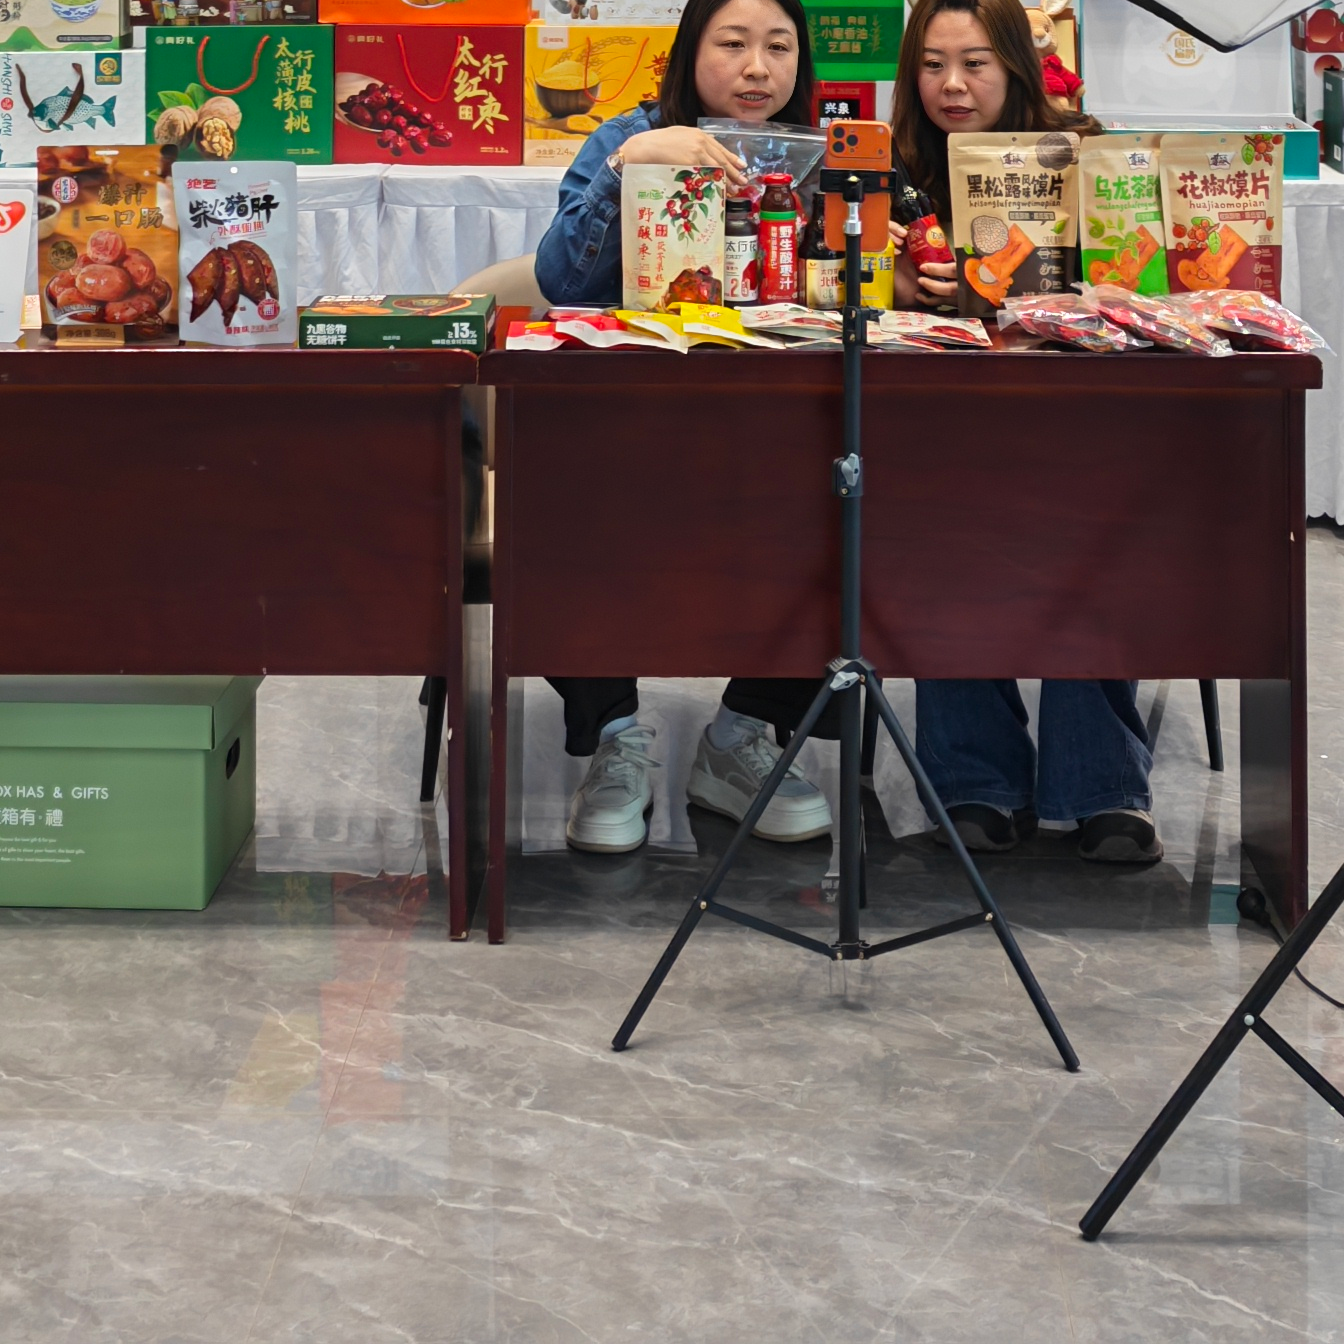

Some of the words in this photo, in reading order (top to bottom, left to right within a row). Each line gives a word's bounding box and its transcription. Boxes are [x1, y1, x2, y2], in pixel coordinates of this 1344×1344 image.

[1177, 169, 1270, 200] 花椒馍片
[16, 786, 44, 798] HAS
[53, 787, 63, 799] &
[71, 787, 109, 800] GIFTS
